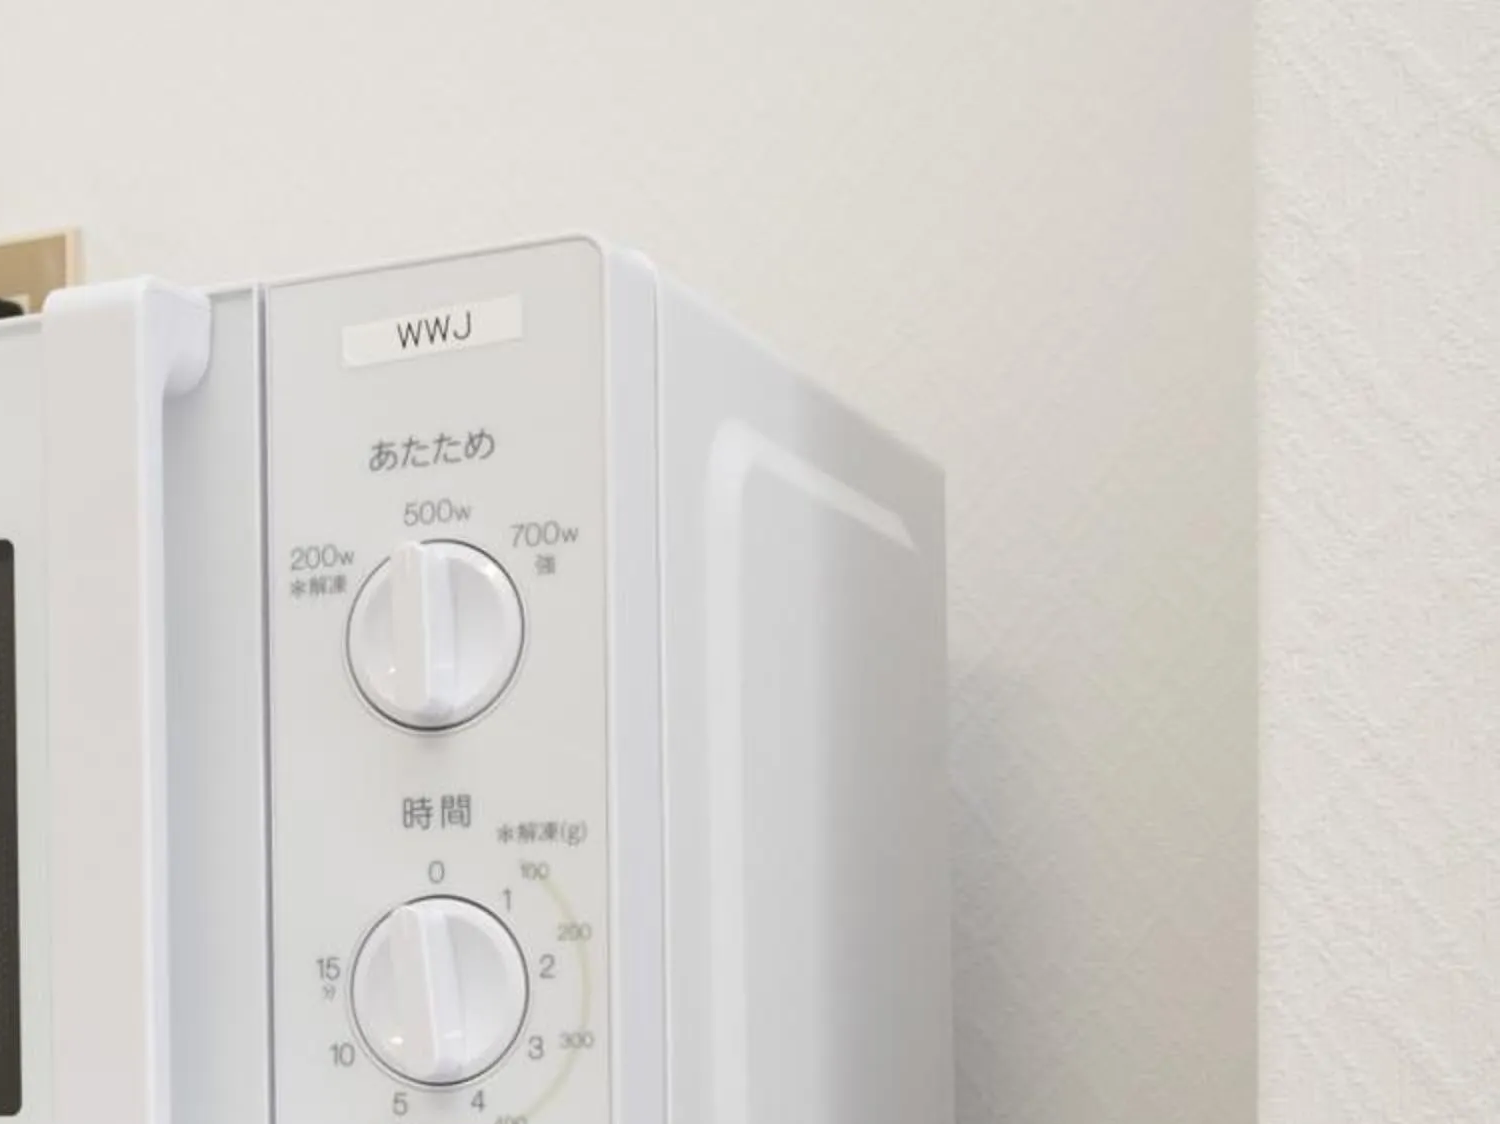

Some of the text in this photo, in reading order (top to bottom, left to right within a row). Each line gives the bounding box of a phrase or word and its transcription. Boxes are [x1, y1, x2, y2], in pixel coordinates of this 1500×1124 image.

[397, 310, 472, 349] WWJ
[368, 428, 495, 471] あたため
[402, 794, 471, 830] 時間
[428, 860, 445, 884] 0
[503, 888, 512, 911] 1
[557, 923, 592, 943] 200
[316, 957, 341, 981] 15
[539, 954, 556, 979] 2
[528, 1036, 545, 1060] 3
[559, 1032, 594, 1050] 300
[330, 1044, 355, 1067] 10
[393, 1092, 409, 1116] 5
[470, 1090, 486, 1113] 4
